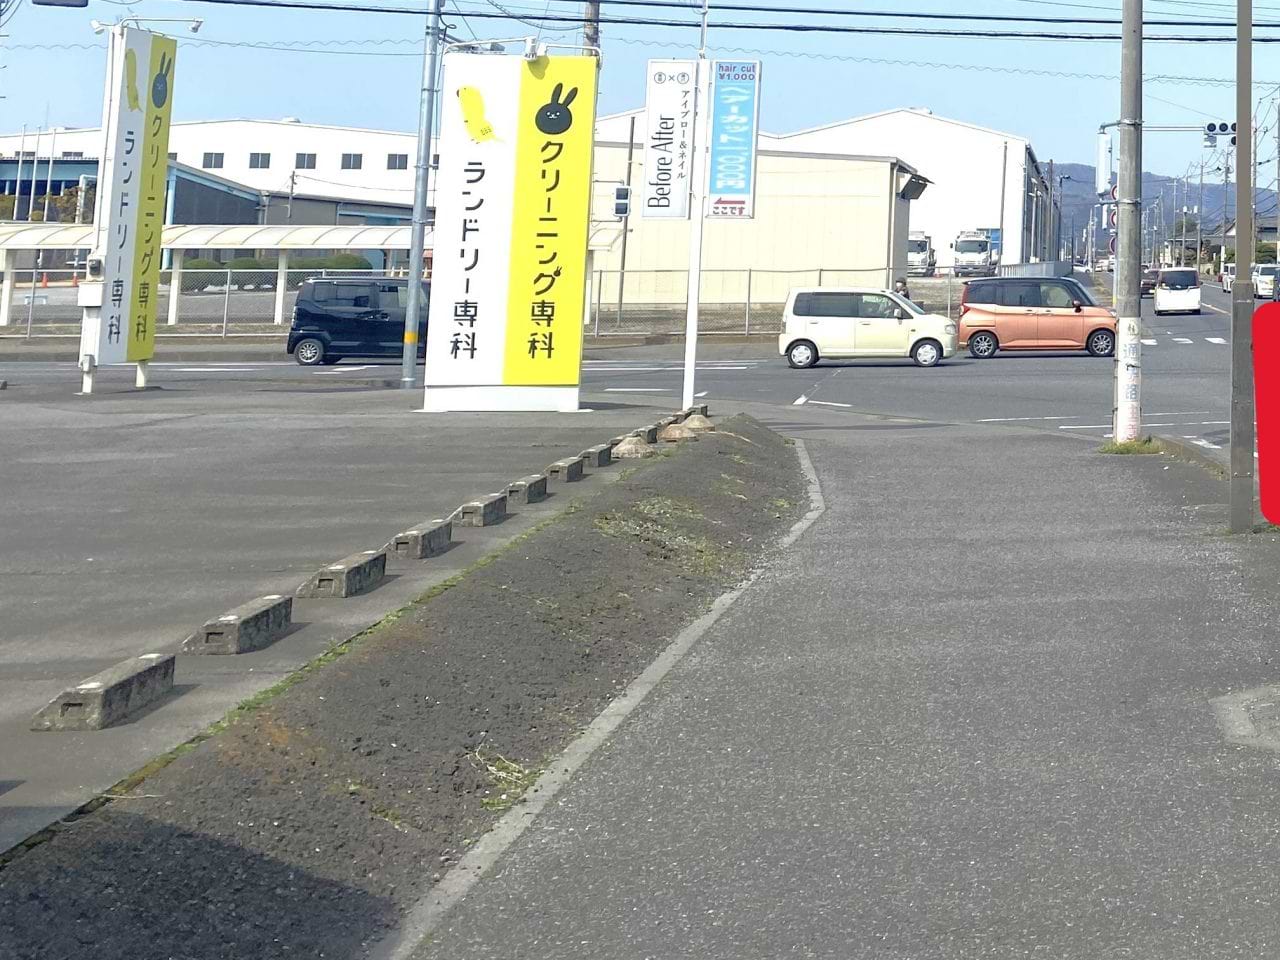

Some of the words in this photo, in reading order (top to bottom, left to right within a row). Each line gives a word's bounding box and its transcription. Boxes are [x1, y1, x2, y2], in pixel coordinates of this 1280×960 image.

[718, 63, 736, 73] hair
[740, 63, 755, 73] cut
[647, 156, 673, 208] Before
[650, 114, 675, 153] After
[107, 130, 135, 345] ランドリー専科
[135, 114, 162, 343] クリーニング専科
[450, 161, 486, 360] ランドリー専科
[527, 141, 564, 360] クリーニング専科
[712, 206, 746, 216] ここです
